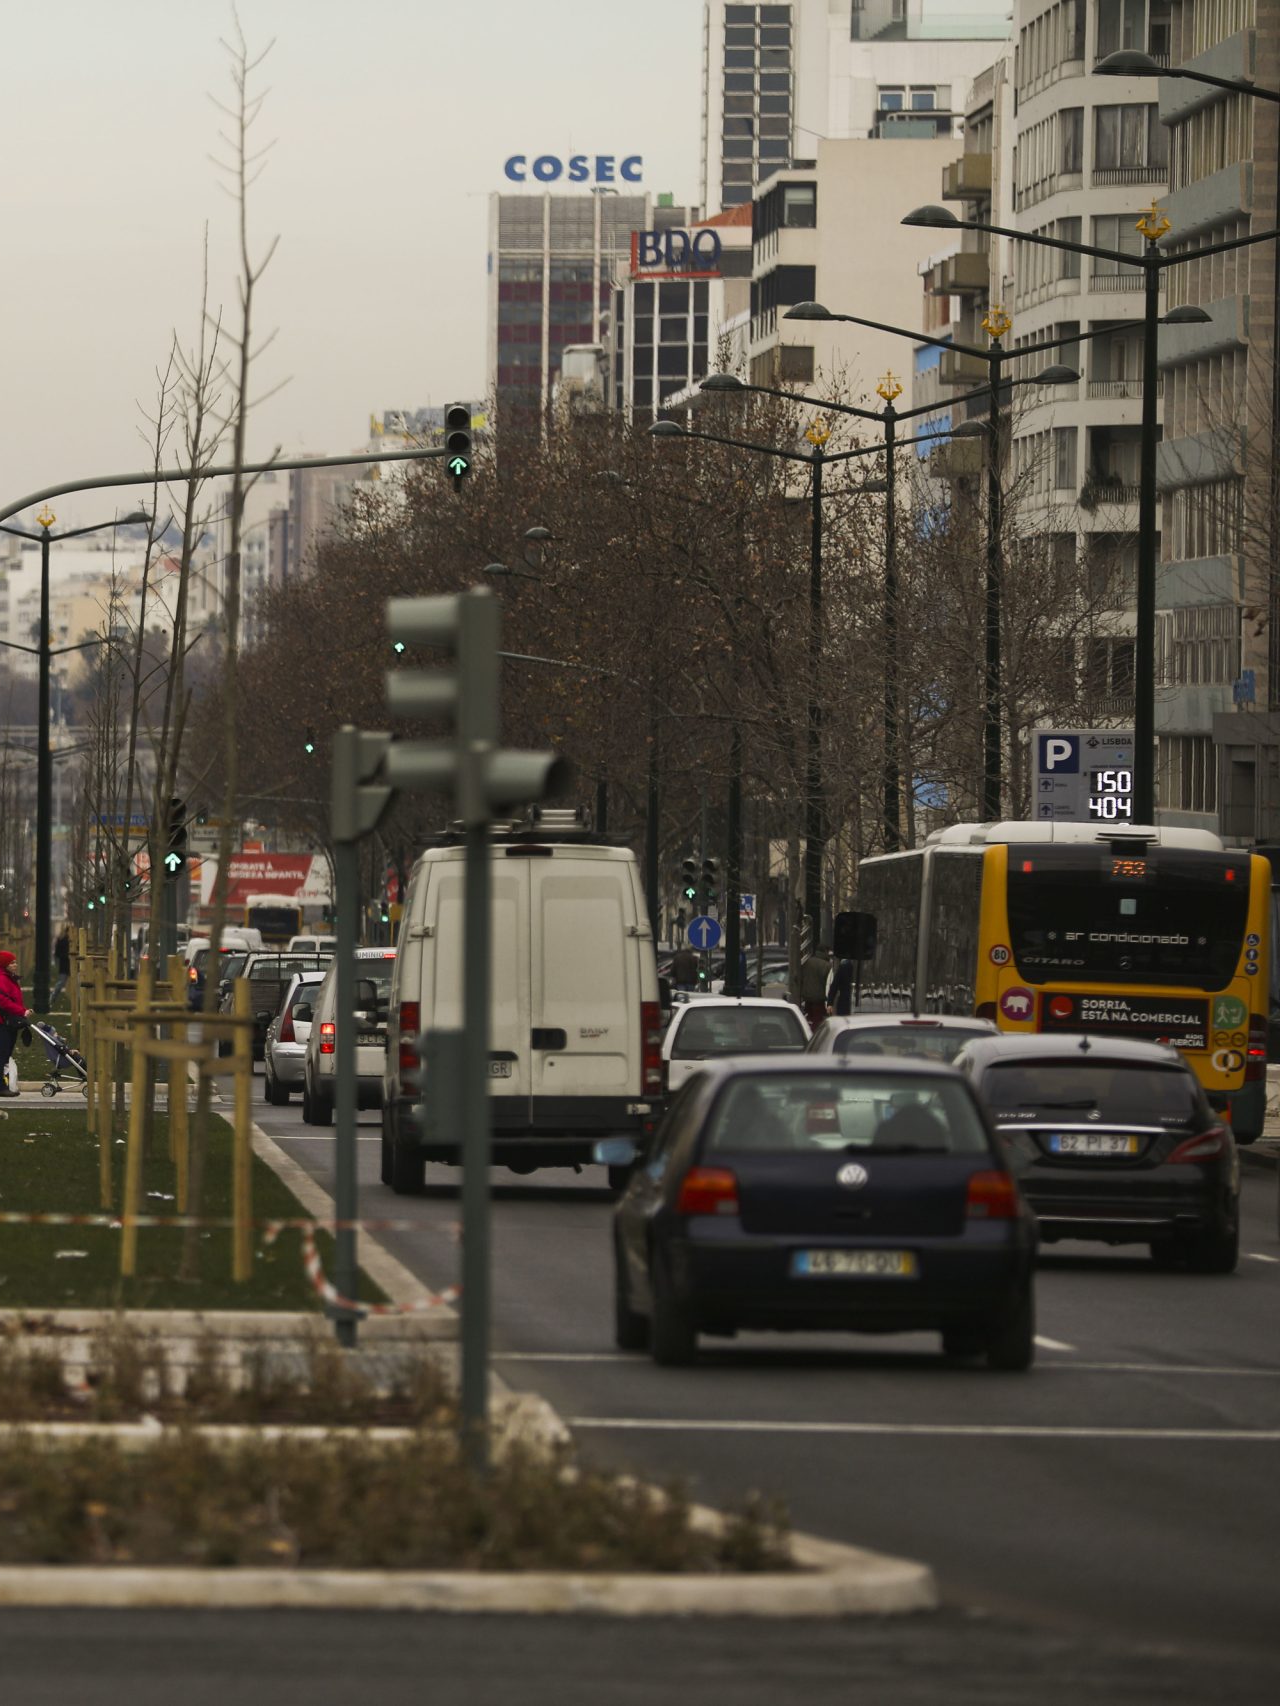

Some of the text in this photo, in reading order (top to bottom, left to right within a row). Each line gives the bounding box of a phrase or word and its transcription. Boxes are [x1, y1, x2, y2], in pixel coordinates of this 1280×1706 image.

[504, 155, 643, 182] COSEC
[638, 229, 722, 267] BDO
[1046, 738, 1073, 770] P
[1097, 771, 1131, 792] 150
[1089, 797, 1131, 818] 404
[1065, 932, 1189, 945] ar condicionado
[994, 949, 1006, 960] 80
[1022, 956, 1086, 966] CITARO
[1081, 999, 1131, 1011] SORRIA,
[1081, 1008, 1201, 1025] ESTÁ NA COMERCIAL
